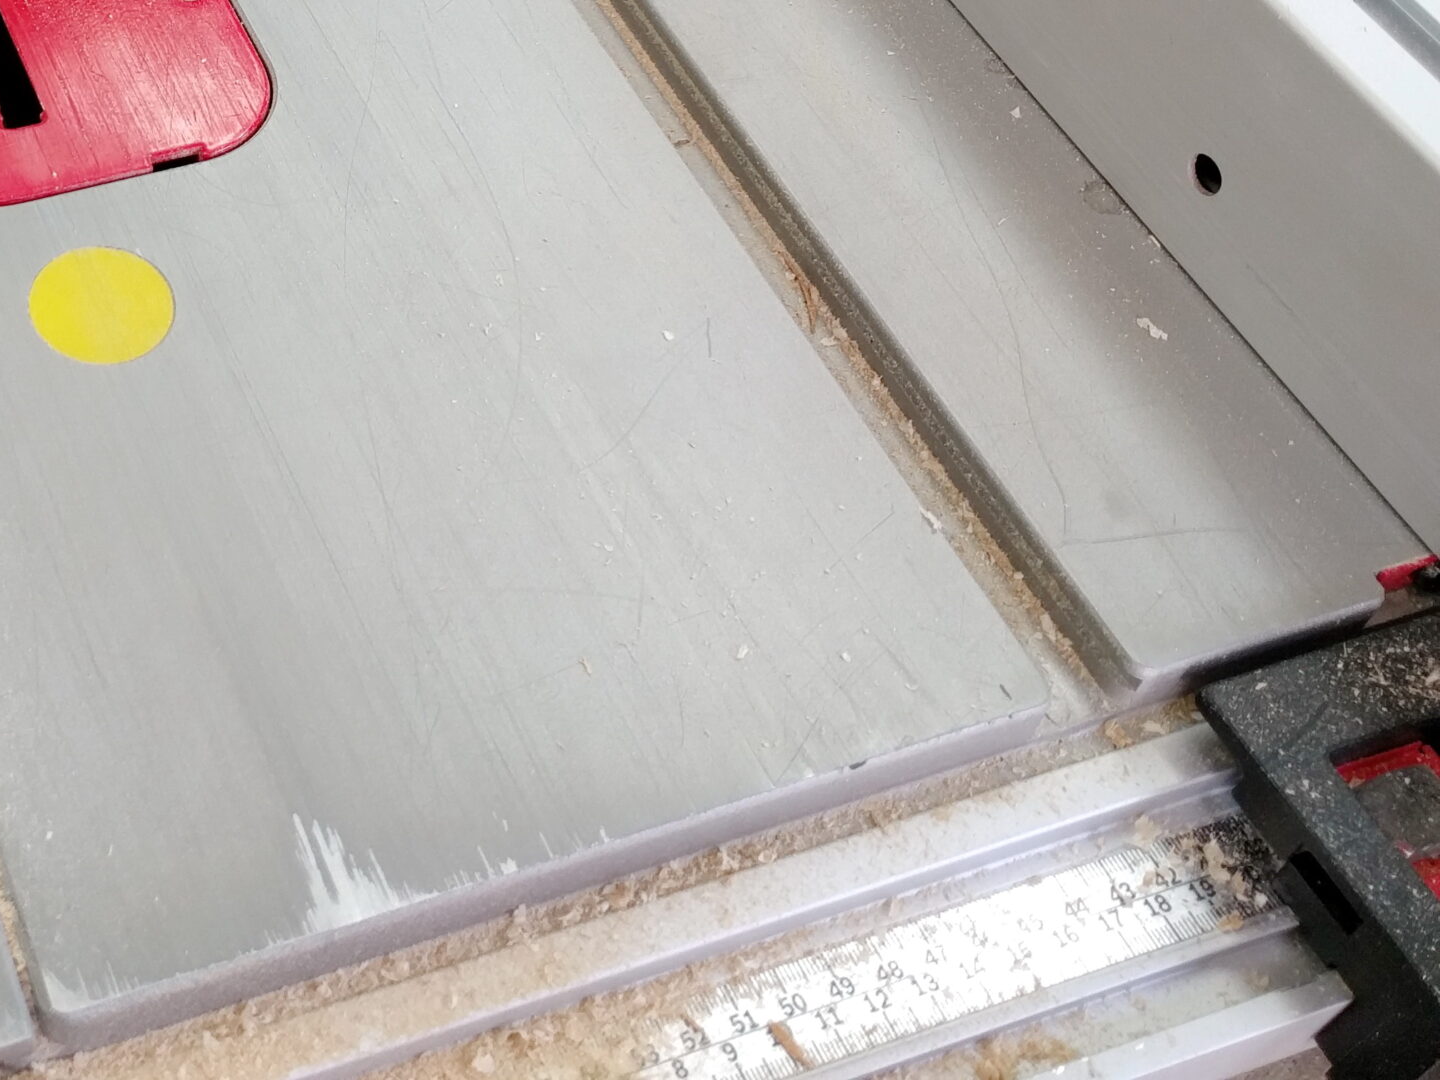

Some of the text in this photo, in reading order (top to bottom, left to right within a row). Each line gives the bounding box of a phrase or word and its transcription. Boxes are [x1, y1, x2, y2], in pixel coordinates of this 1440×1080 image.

[671, 1059, 689, 1080] 8
[722, 1042, 739, 1063] 9
[815, 1007, 845, 1030] 11
[864, 988, 893, 1013] 12
[911, 973, 940, 996] 13
[1053, 924, 1080, 948] 16
[1099, 909, 1124, 932] 17
[1144, 894, 1172, 917] 18
[1189, 880, 1217, 901] 19
[680, 1029, 710, 1051] 52
[729, 1010, 759, 1034] 51
[778, 993, 808, 1017] 50
[830, 977, 856, 999] 49
[877, 960, 904, 981] 48
[925, 944, 948, 965] 47
[1065, 897, 1090, 918] 44
[1111, 882, 1137, 907] 43
[1155, 867, 1182, 888] 42
